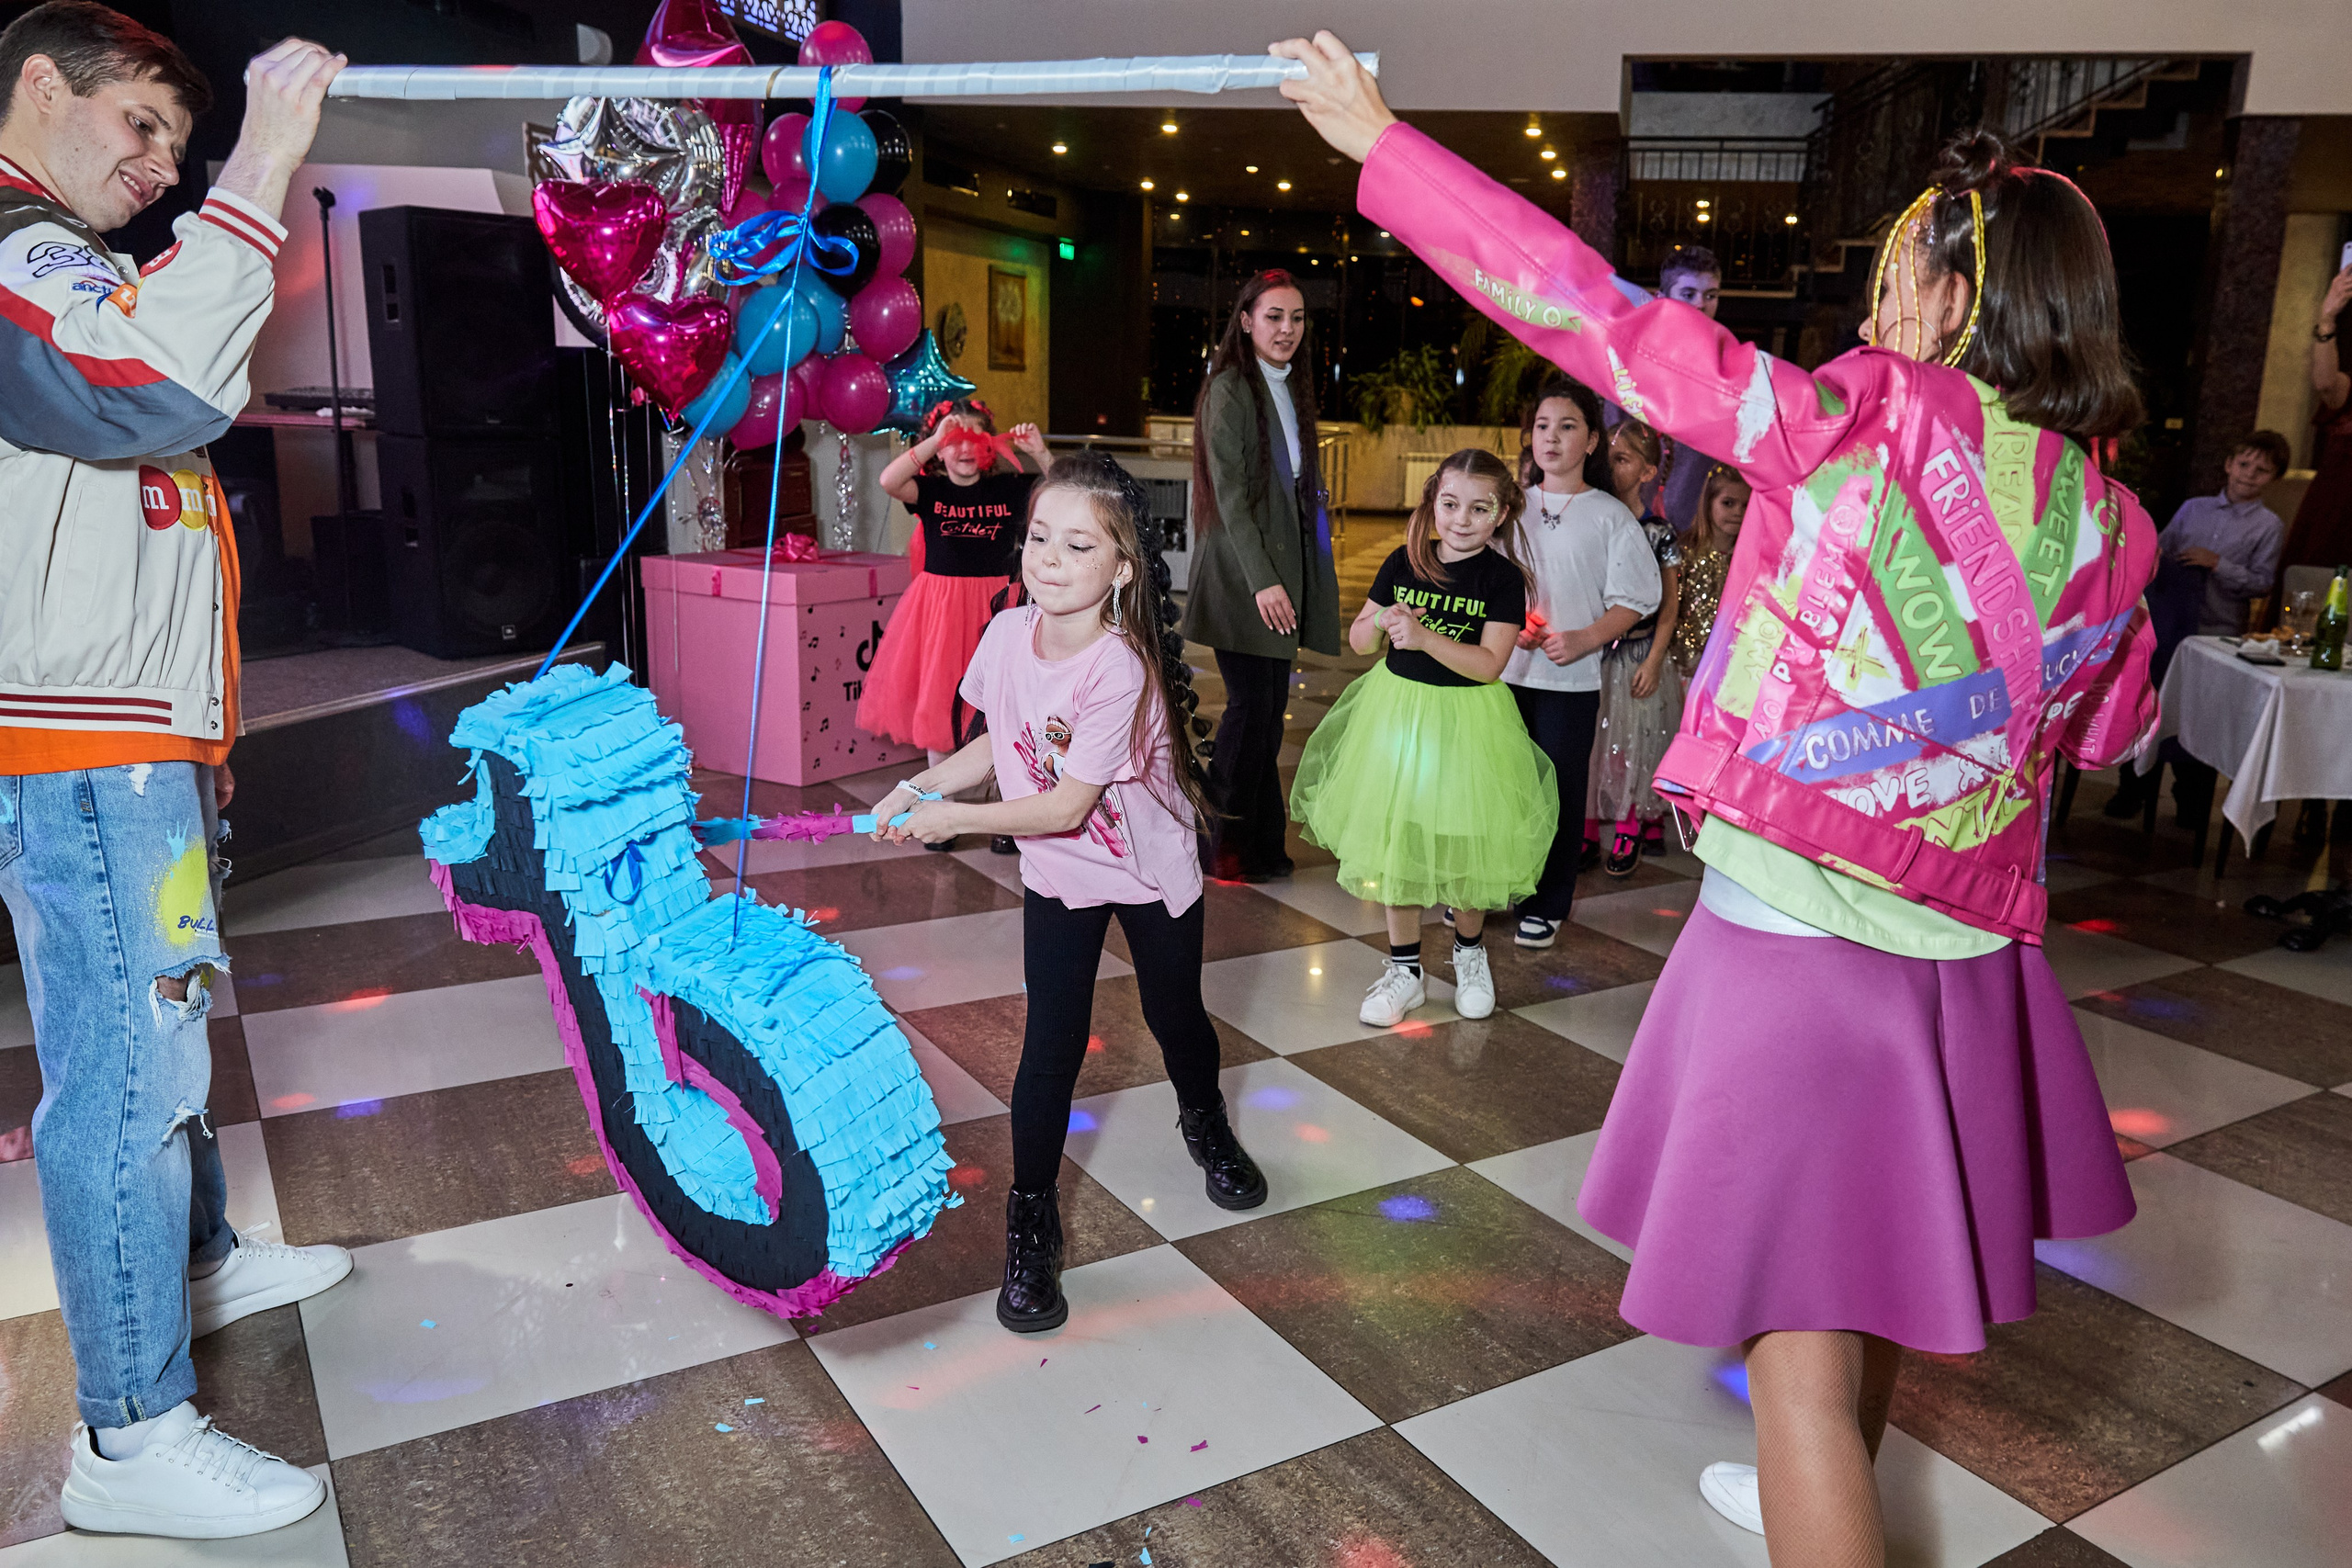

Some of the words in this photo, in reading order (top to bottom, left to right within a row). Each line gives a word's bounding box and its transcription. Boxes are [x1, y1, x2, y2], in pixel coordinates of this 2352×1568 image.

[933, 501, 1012, 519] BEAUTIFUL
[2029, 448, 2080, 597] SWEET
[1885, 530, 1963, 680] WOW
[1805, 708, 1934, 771] COMME
[1843, 767, 1931, 818] OVE
